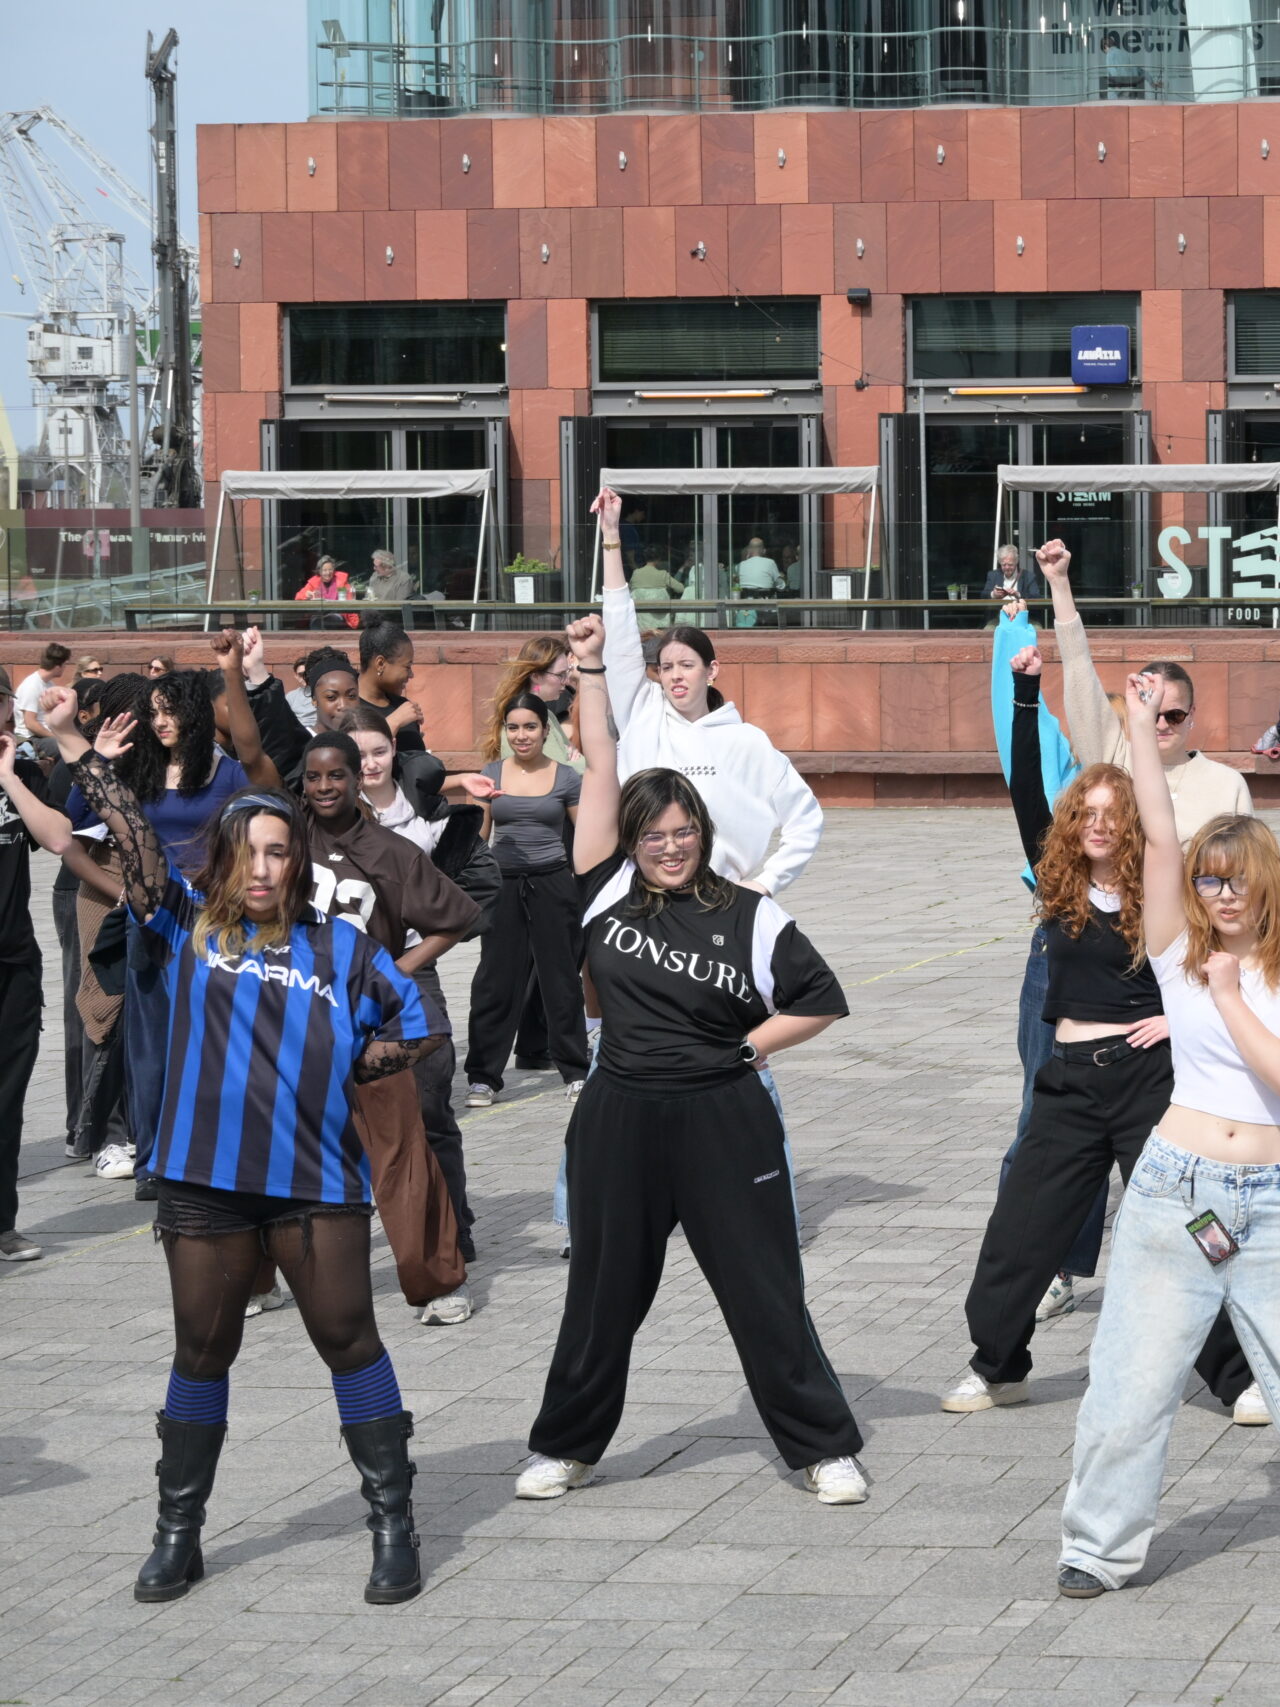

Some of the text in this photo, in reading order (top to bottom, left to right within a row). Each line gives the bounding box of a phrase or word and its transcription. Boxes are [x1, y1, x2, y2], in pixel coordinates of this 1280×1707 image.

[1077, 347, 1122, 361] LAVAZZA
[1227, 607, 1261, 622] FOOD
[603, 916, 753, 1004] TONSURE
